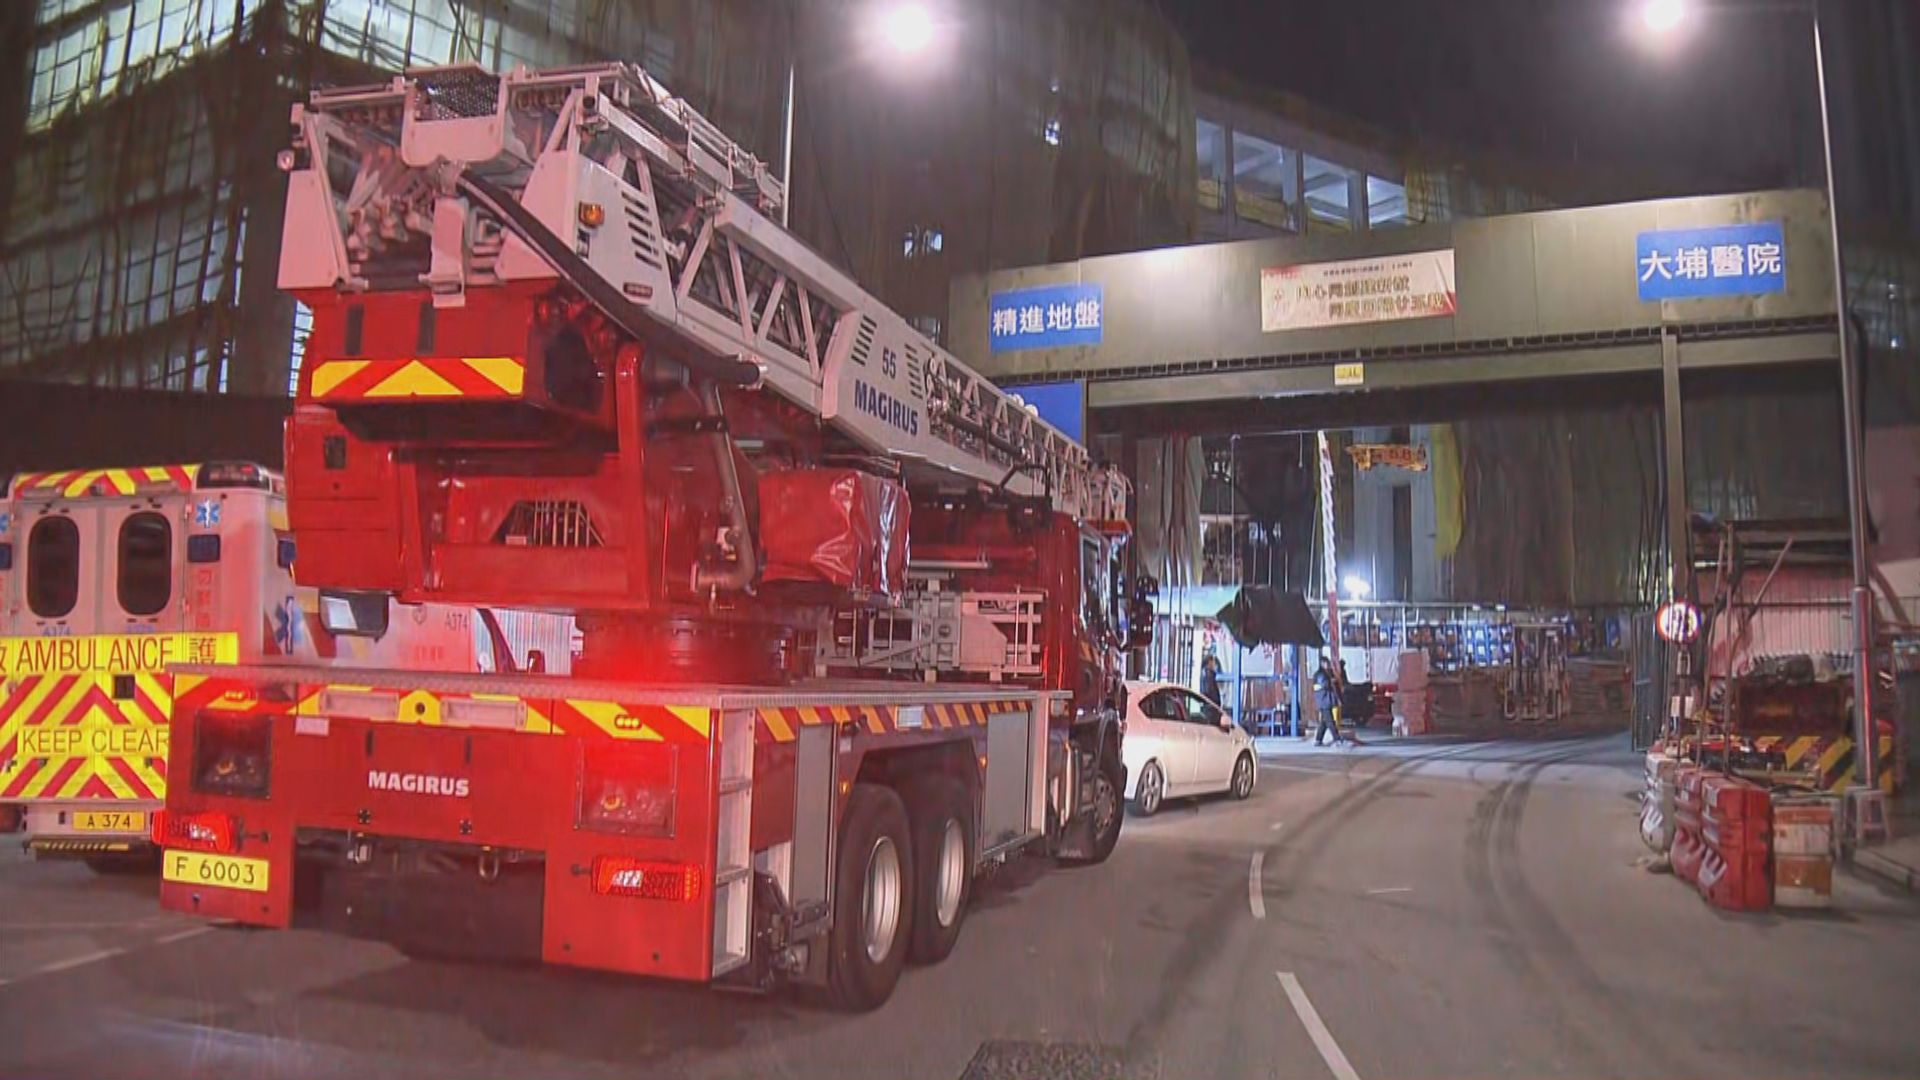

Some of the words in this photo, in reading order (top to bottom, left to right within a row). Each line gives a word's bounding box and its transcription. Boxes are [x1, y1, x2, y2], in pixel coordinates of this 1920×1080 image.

[1640, 242, 1782, 282] 大埔醫院
[993, 298, 1100, 337] 精進地盤
[882, 346, 897, 379] 55
[855, 378, 918, 436] MAGIRUS
[445, 613, 469, 633] A374
[16, 635, 173, 672] AMBULANCE
[22, 729, 82, 754] KEEP
[368, 770, 470, 797] MAGIRUS
[87, 814, 96, 828] A
[102, 812, 131, 829] 374
[175, 856, 189, 878] F
[199, 858, 255, 885] 6003
